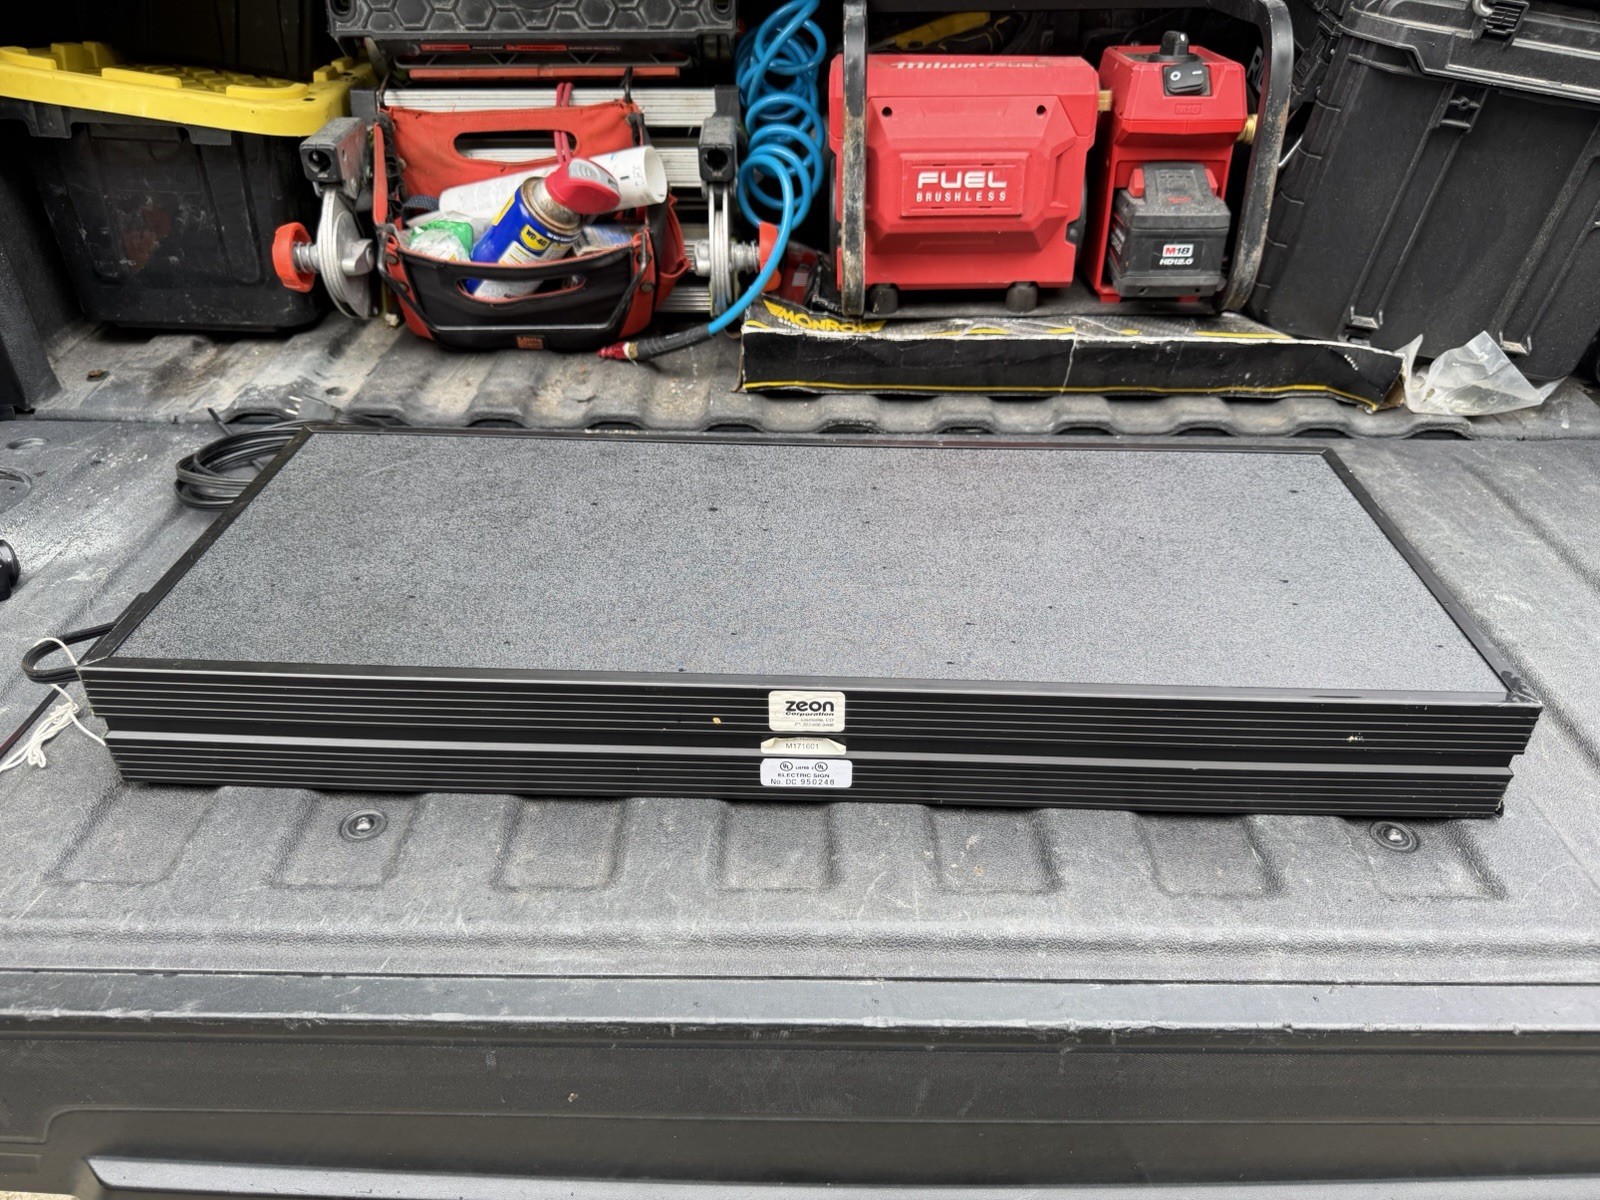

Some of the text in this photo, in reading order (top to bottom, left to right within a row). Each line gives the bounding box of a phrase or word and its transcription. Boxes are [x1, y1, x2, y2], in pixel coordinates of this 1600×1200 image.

[917, 171, 1008, 189] FUEL
[916, 191, 1007, 202] BRUSHLESS
[526, 228, 548, 247] WD-40
[1164, 246, 1191, 255] M18
[1159, 258, 1195, 266] HD12.0
[785, 700, 835, 712] zeon
